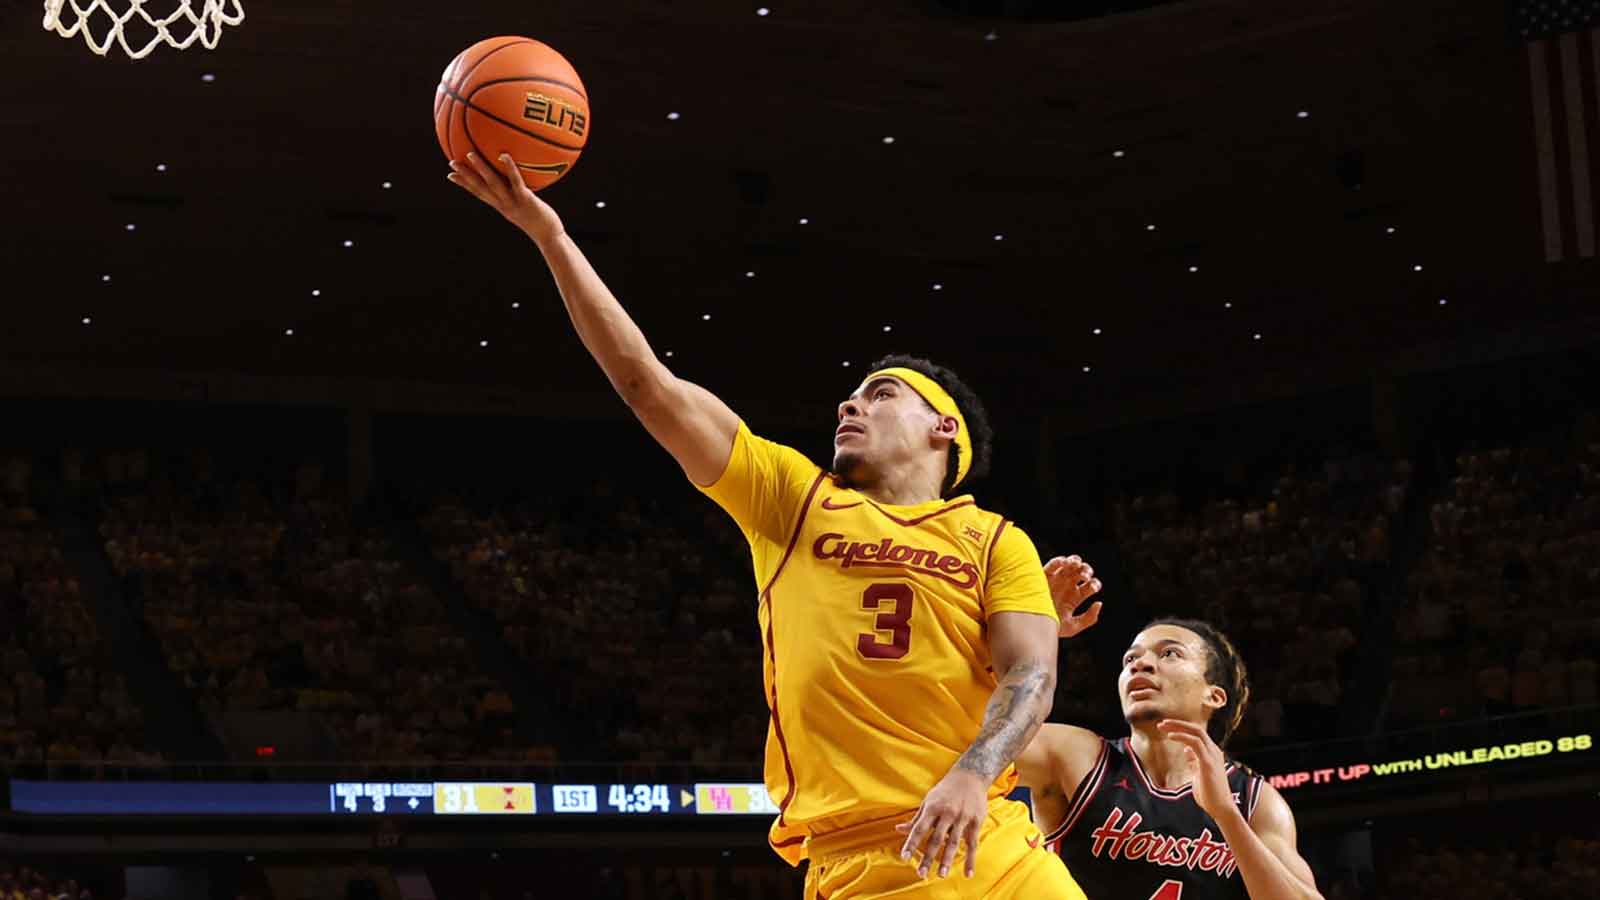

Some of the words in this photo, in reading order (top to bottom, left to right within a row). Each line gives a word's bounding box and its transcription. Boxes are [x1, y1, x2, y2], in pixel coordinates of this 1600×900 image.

[523, 97, 586, 137] ELITE
[812, 532, 979, 590] Cyclones
[856, 582, 914, 661] 3
[1313, 768, 1335, 784] IT
[1338, 764, 1370, 780] UP
[1372, 758, 1423, 776] WITH
[1424, 739, 1553, 769] UNLEADED
[1556, 734, 1593, 752] 88
[443, 783, 480, 813] 31
[608, 784, 671, 813] 4:34
[1091, 806, 1239, 879] Houston
